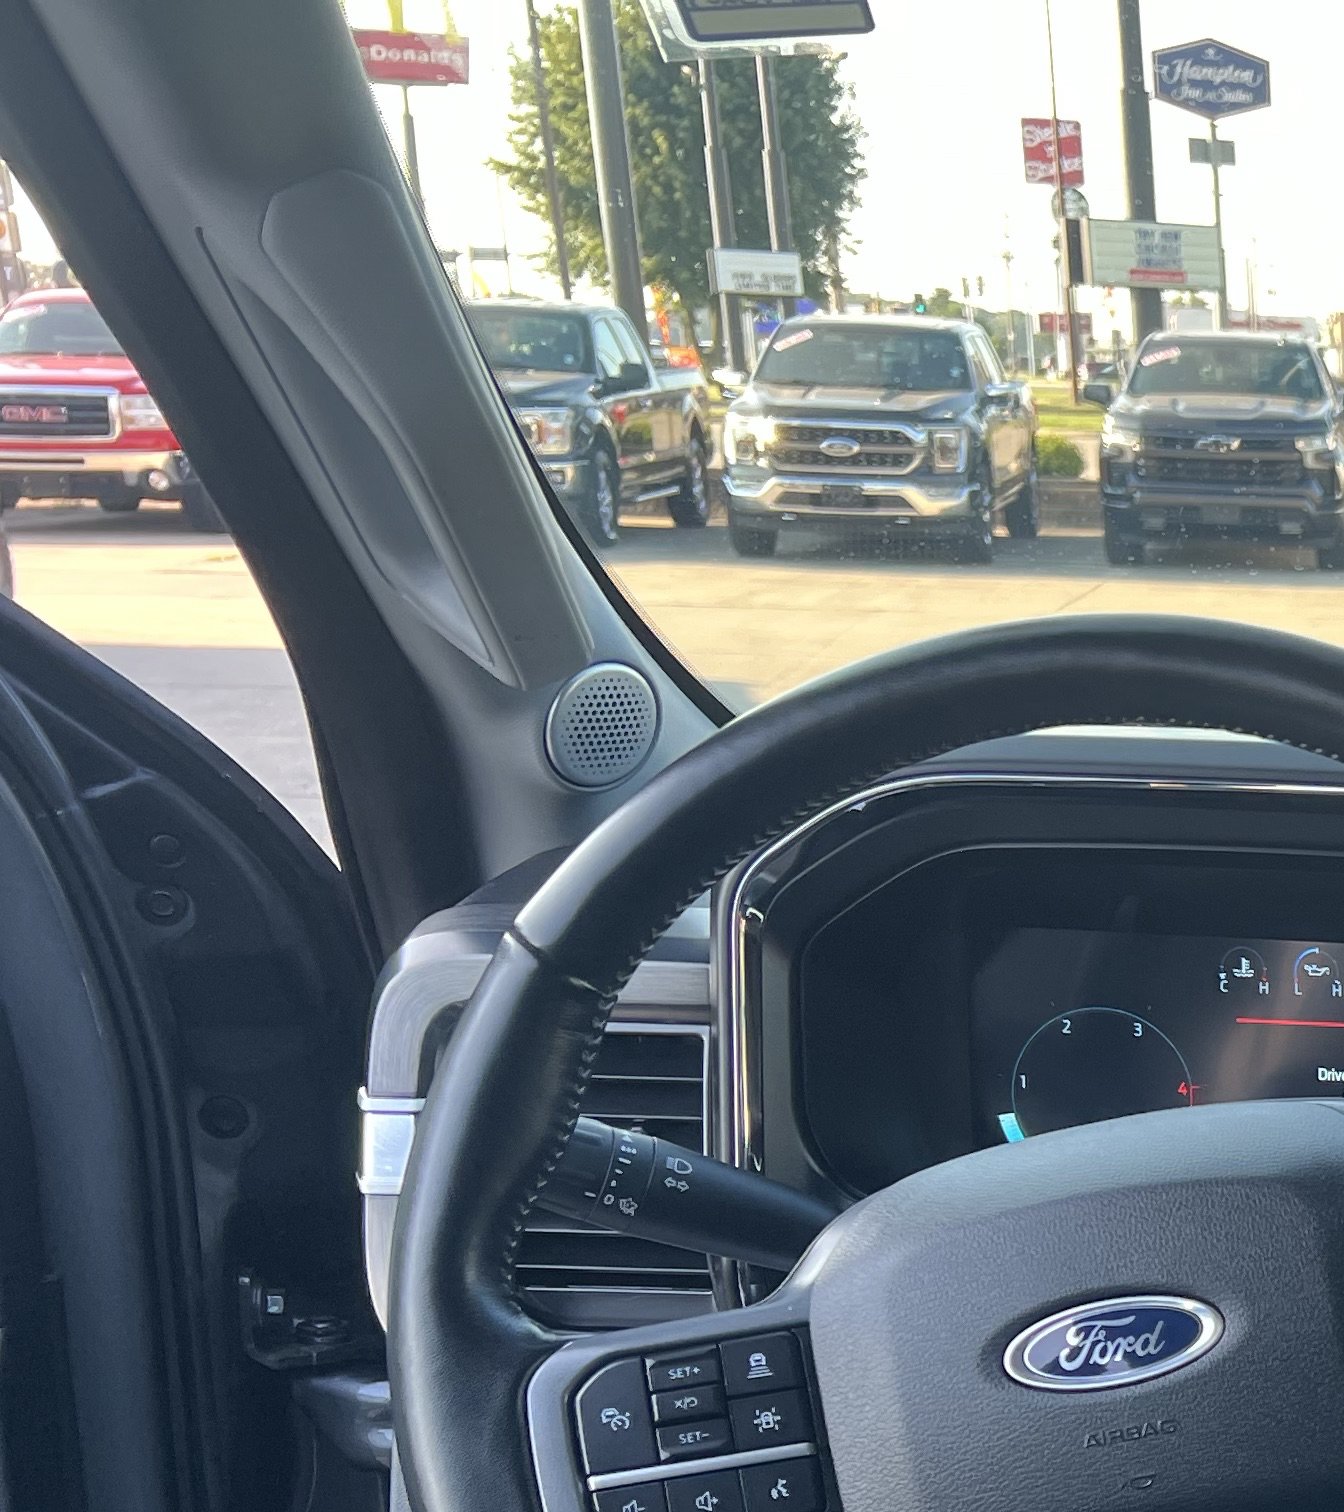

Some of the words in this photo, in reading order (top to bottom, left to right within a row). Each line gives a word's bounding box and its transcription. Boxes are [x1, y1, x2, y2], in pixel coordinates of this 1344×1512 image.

[1061, 1019, 1072, 1034] 2
[1133, 1022, 1143, 1037] 3
[1019, 1074, 1028, 1089] 1
[1177, 1081, 1188, 1096] 4
[1058, 1315, 1166, 1372] Ford
[1083, 1419, 1182, 1448] AIRBAG
